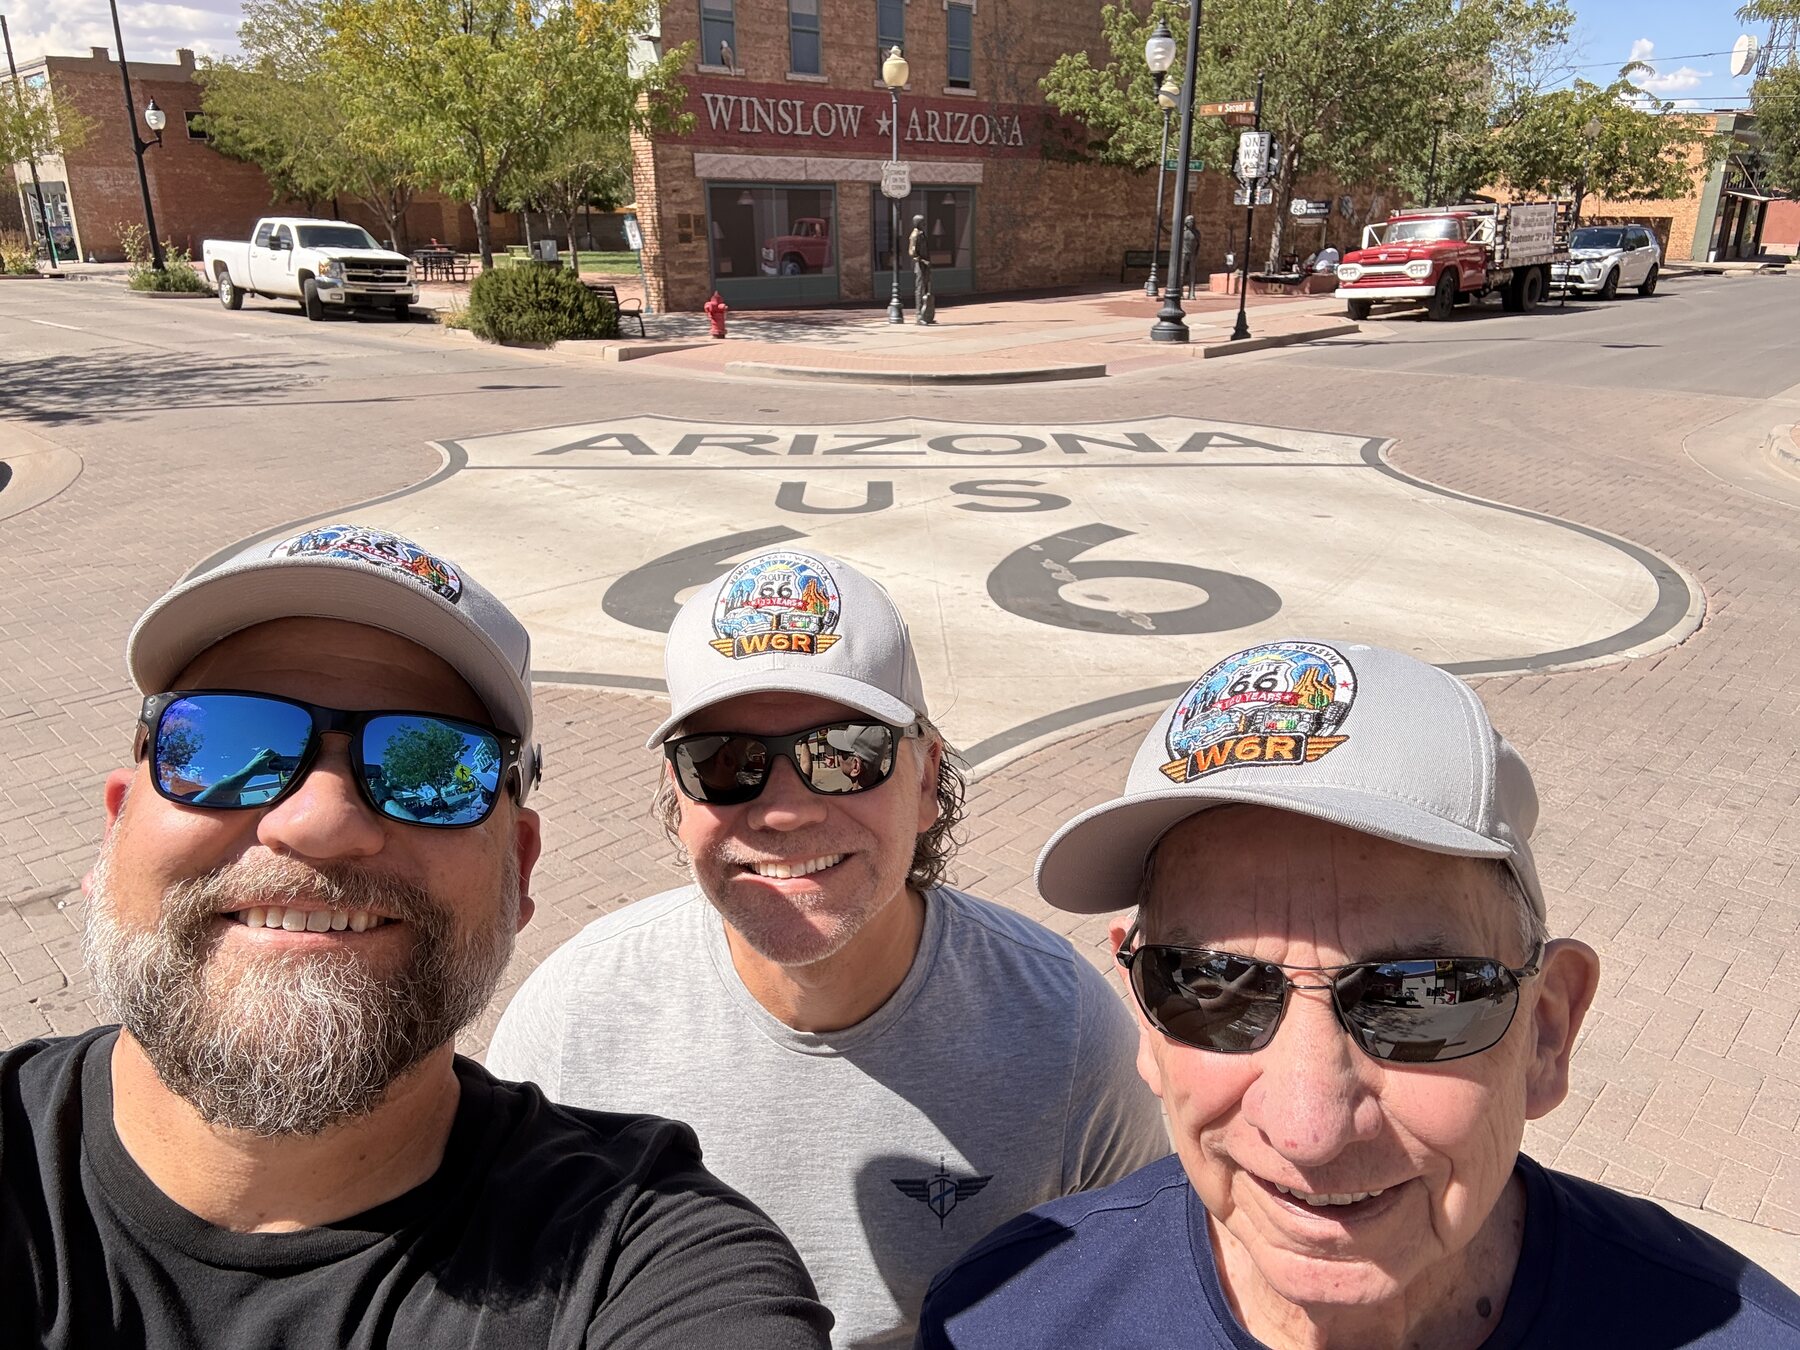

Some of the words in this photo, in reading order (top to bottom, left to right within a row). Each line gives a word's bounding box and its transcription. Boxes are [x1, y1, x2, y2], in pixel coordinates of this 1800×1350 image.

[1225, 102, 1246, 112] Second
[701, 92, 865, 138] WINSLOW
[904, 106, 1024, 147] ARIZONA
[1245, 136, 1266, 147] ONE
[1244, 149, 1266, 160] WAY
[1293, 205, 1304, 213] 66
[534, 432, 1306, 456] ARIZONA
[761, 573, 792, 582] ROUTE
[759, 581, 793, 599] 66
[772, 598, 797, 607] YEARS
[740, 633, 812, 654] W6R
[1240, 663, 1283, 676] ROUTE
[1228, 671, 1278, 697] 66
[1224, 696, 1242, 708] 100
[1245, 692, 1282, 702] YEARS
[1194, 735, 1296, 772] W6R
